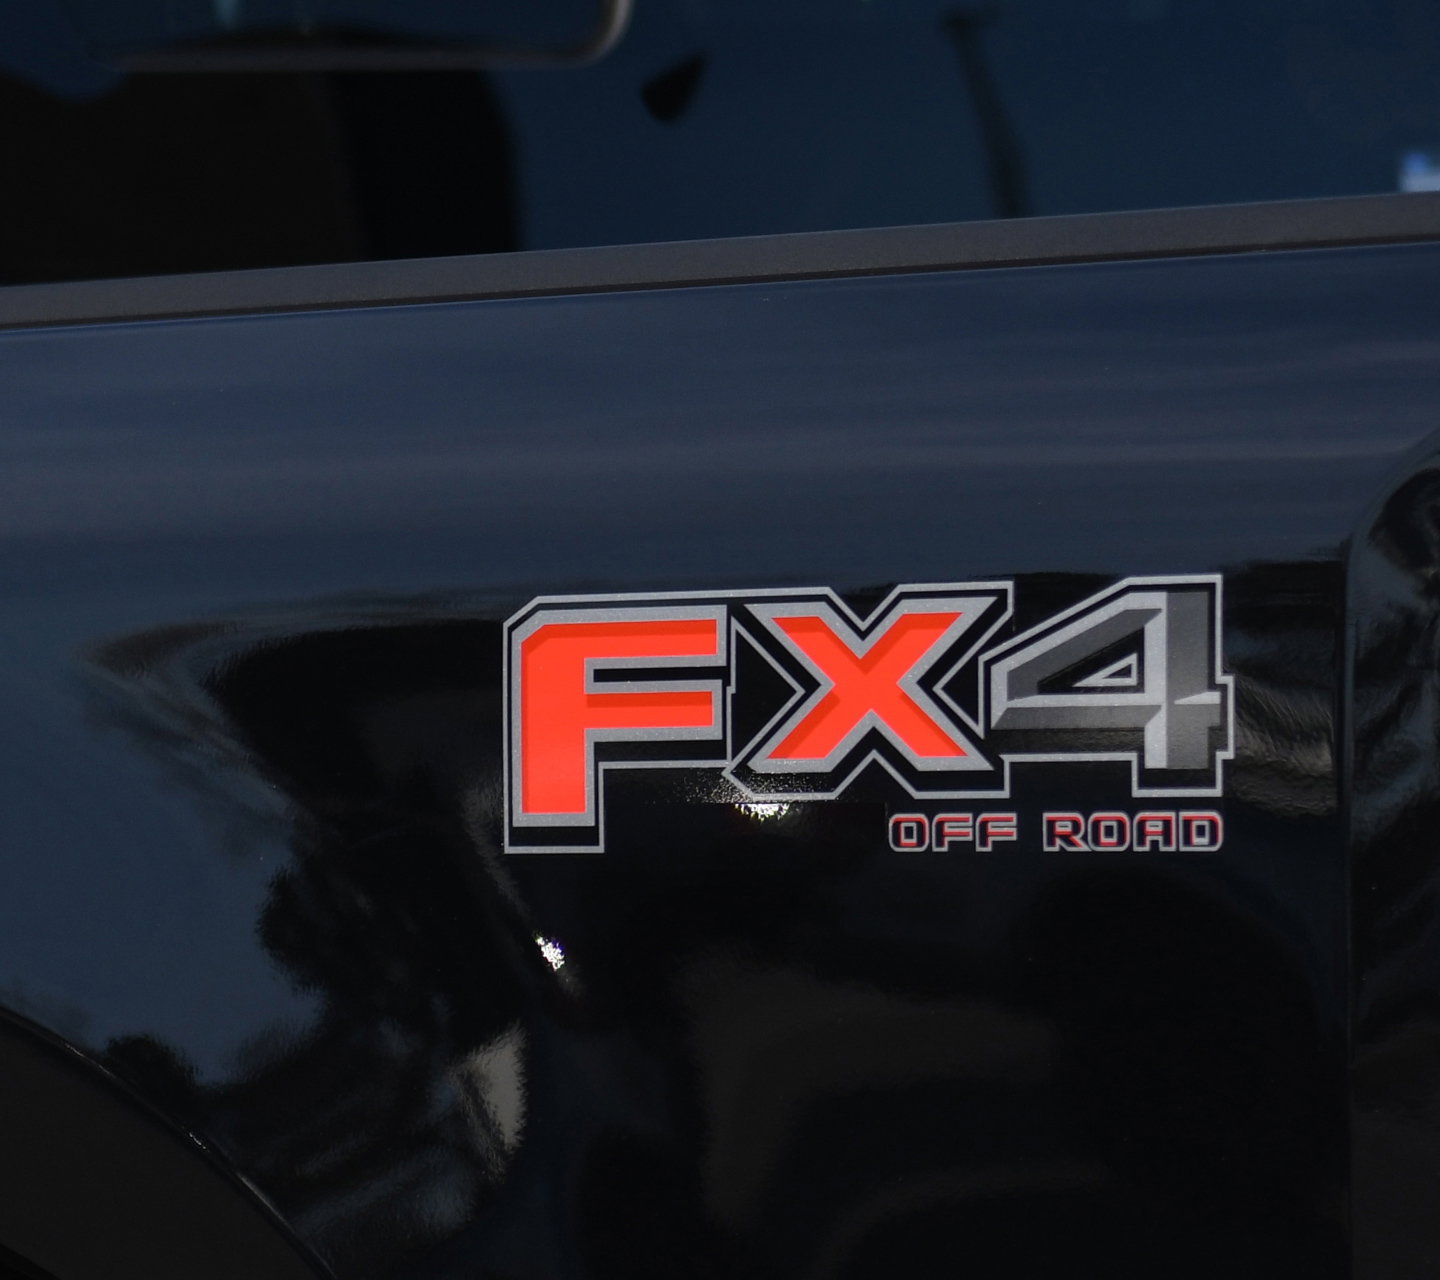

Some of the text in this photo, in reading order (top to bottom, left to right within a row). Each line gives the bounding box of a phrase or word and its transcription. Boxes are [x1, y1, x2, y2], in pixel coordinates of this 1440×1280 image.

[504, 574, 1234, 854] FX4
[889, 811, 1223, 852] OFF ROAD
